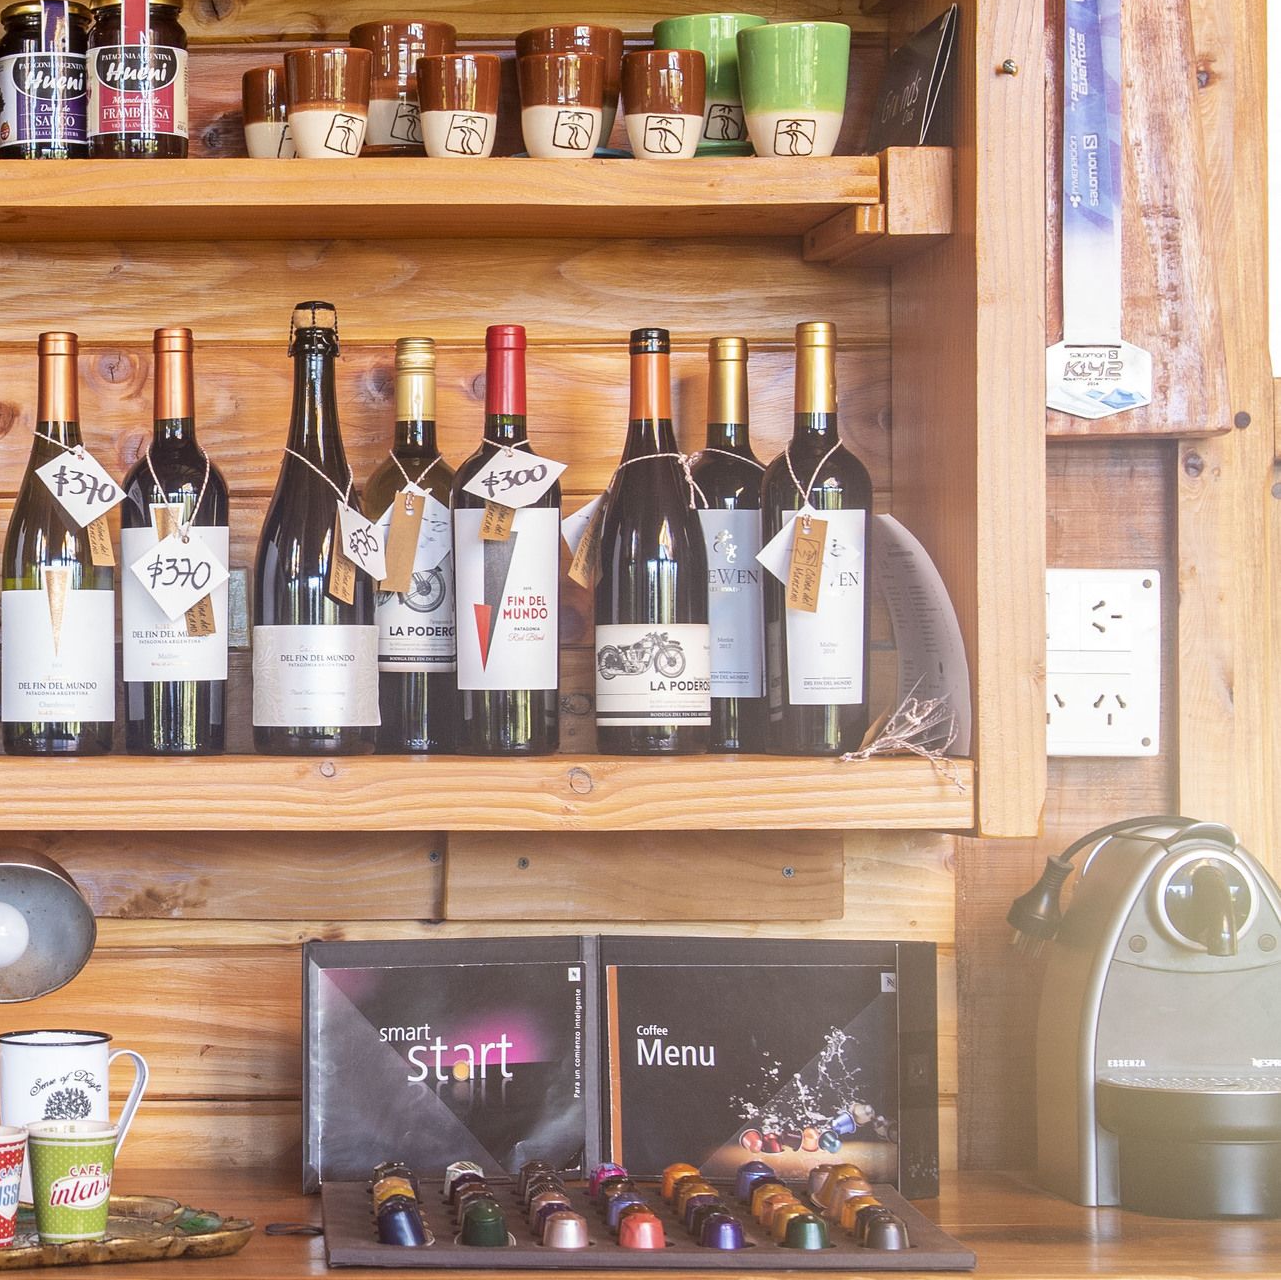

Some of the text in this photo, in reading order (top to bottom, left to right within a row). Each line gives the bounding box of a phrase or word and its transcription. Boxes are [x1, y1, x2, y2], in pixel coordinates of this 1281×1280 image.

[106, 62, 167, 82] Hueni
[1069, 27, 1079, 102] Patagonia
[1078, 32, 1088, 95] Eventos
[25, 71, 83, 91] Hueni
[1089, 152, 1099, 207] salomon
[52, 465, 116, 505] $370
[481, 464, 548, 499] $300
[147, 554, 211, 590] $370
[508, 596, 546, 606] FIN DEL
[503, 608, 548, 619] MUNDO
[389, 627, 405, 637] LA
[280, 654, 294, 662] DEL
[295, 654, 309, 662] FIN
[311, 654, 325, 662] DEL
[650, 682, 666, 691] LA
[574, 988, 582, 1029] inteligente
[379, 1024, 431, 1042] smart
[637, 1025, 668, 1035] Coffee
[407, 1033, 514, 1082] start
[637, 1039, 715, 1066] Menu
[1107, 1059, 1146, 1068] ESSENZA
[575, 1070, 581, 1080] un
[30, 1078, 56, 1097] Sense
